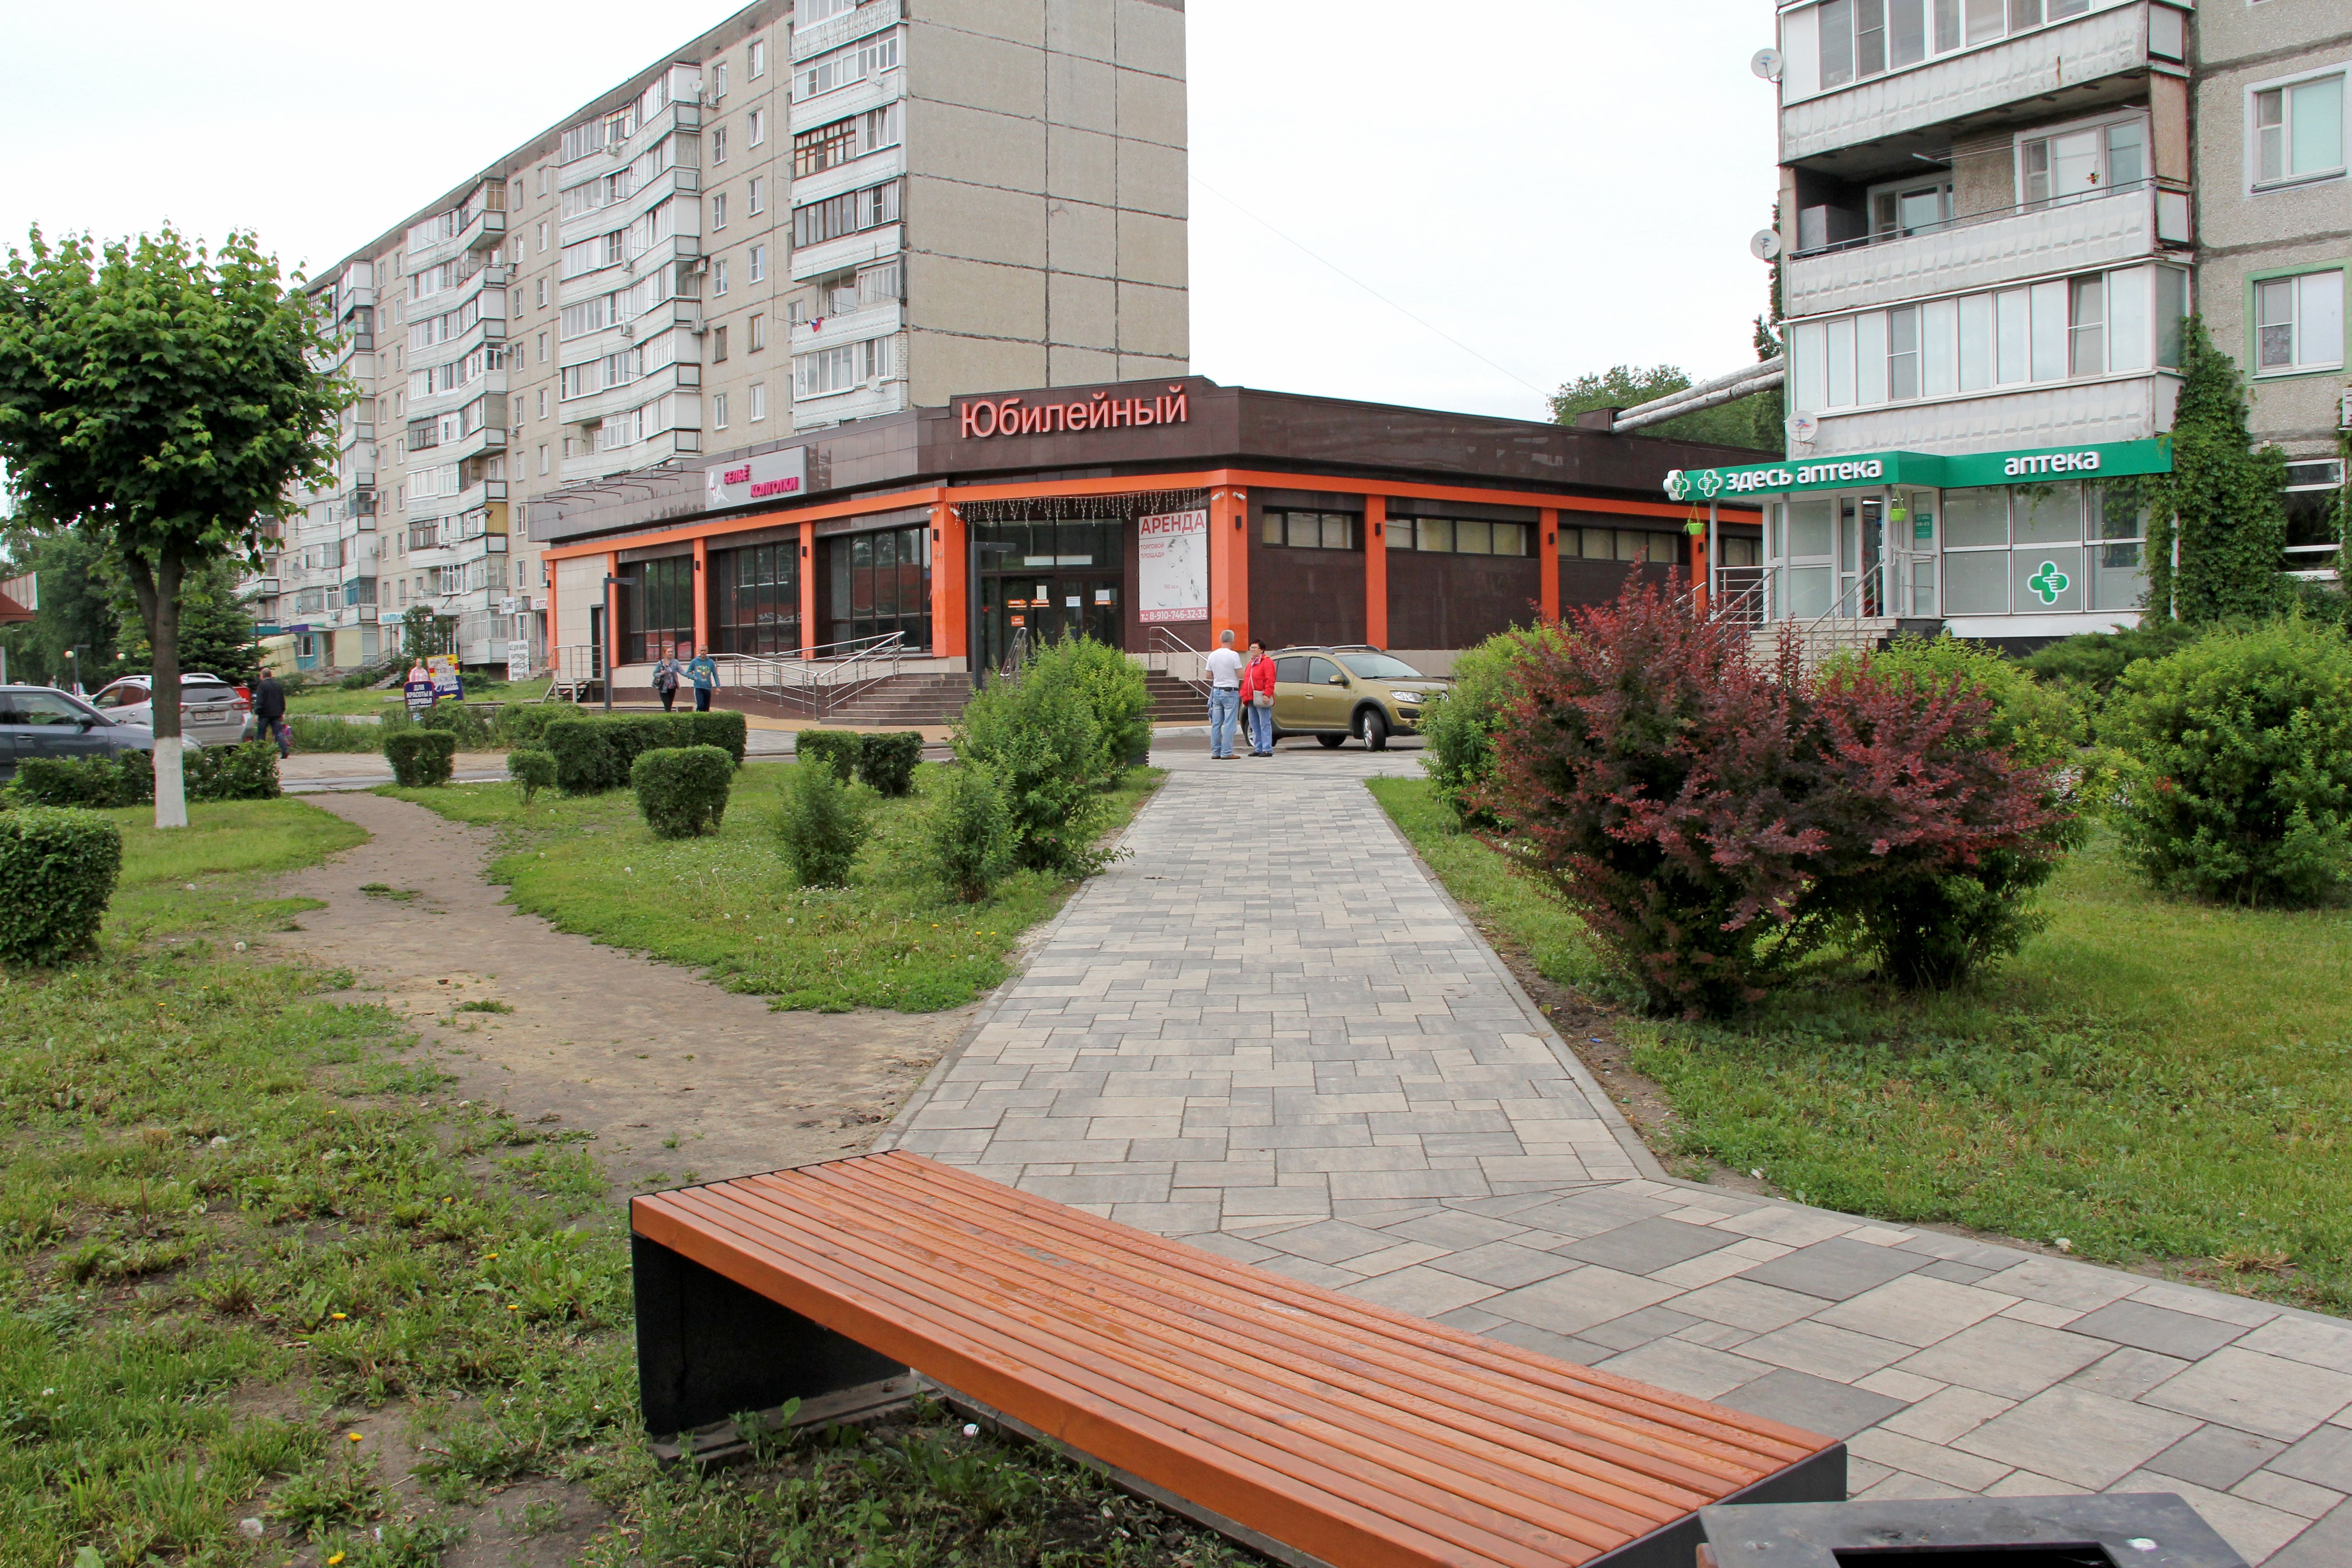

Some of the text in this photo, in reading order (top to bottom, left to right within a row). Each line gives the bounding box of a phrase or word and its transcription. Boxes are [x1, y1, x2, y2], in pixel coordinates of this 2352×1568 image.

[961, 385, 1187, 438] Юбилейный
[2004, 451, 2101, 475] аптека
[724, 464, 750, 485] БЕЛЬЁ
[1725, 460, 1882, 492] здесь аптека
[750, 476, 799, 498] КОЛГОТКИ
[1141, 513, 1205, 535] АРЕНДА
[1140, 542, 1165, 550] ТОРГОВОЙ
[1150, 609, 1207, 620] 8-910-746-32-32
